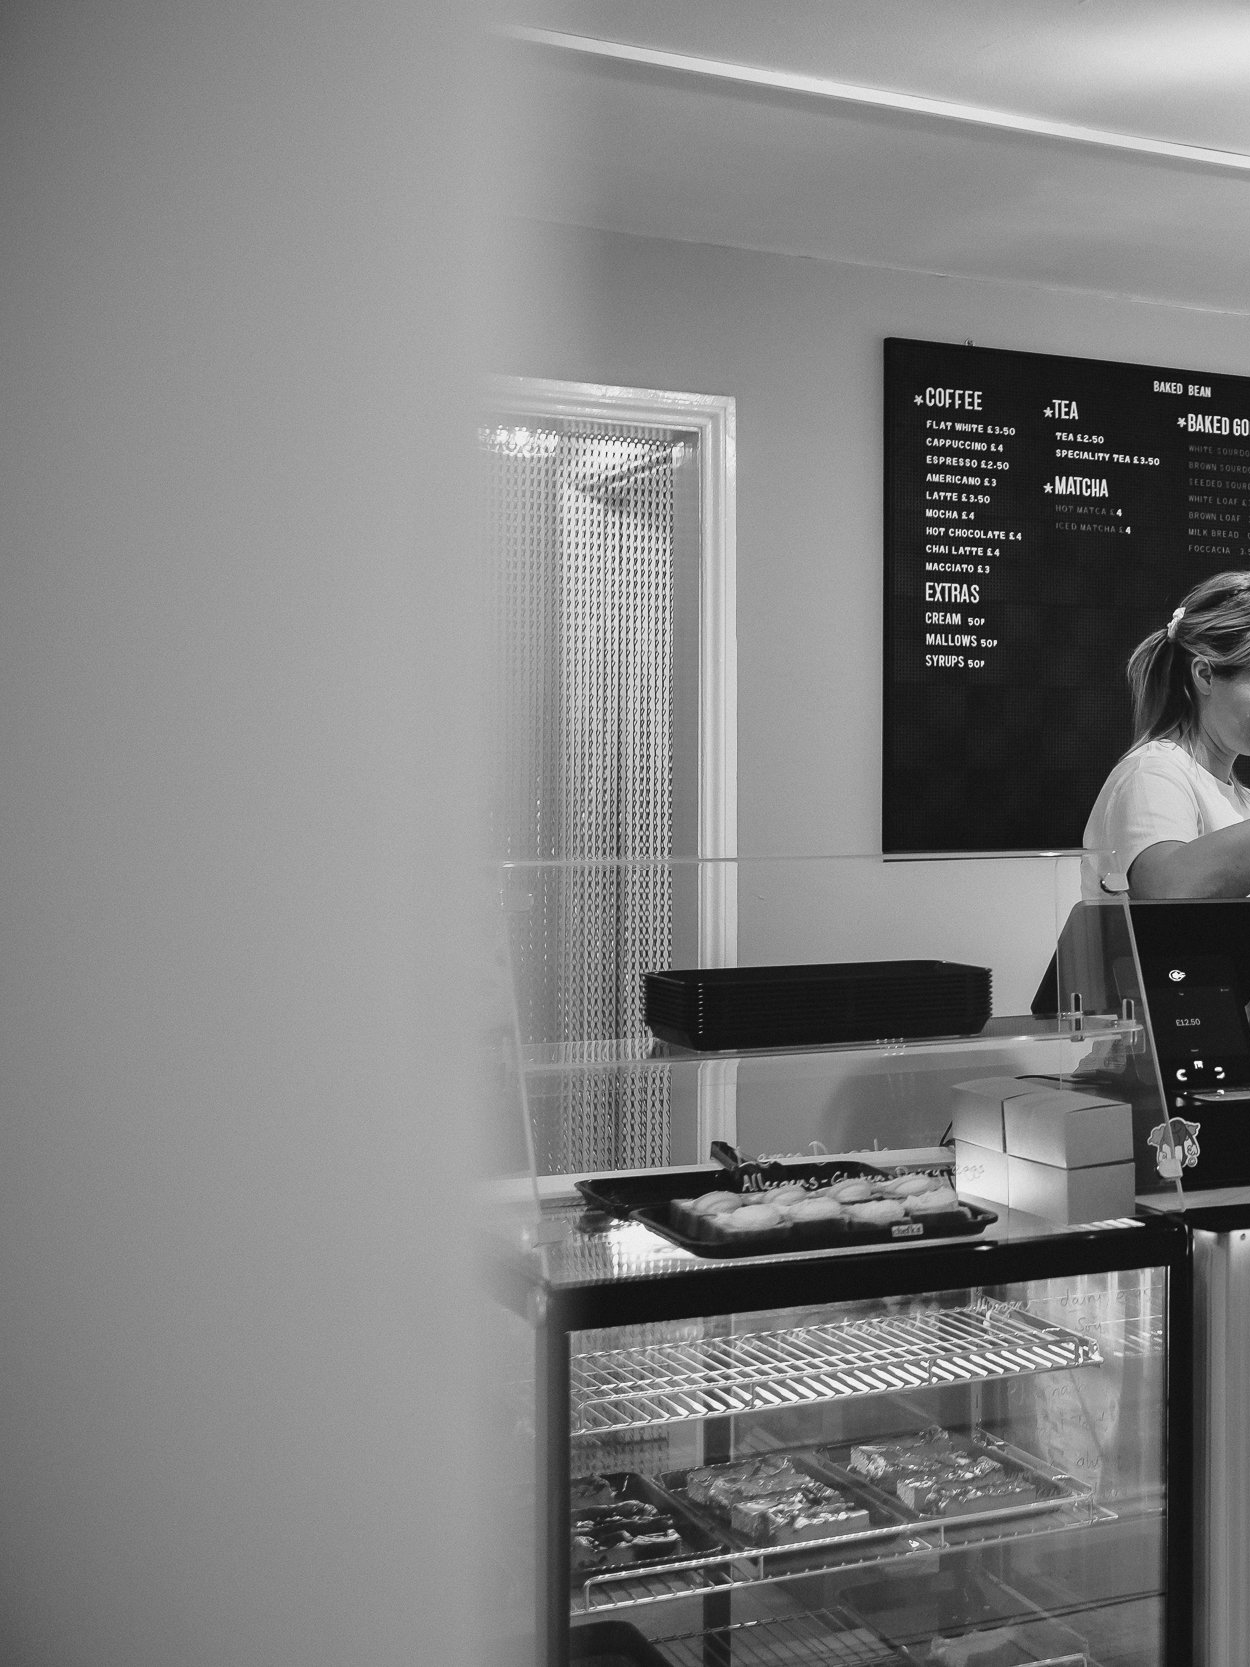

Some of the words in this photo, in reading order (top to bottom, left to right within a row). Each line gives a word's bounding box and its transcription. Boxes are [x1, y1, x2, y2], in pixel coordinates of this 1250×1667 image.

[1154, 381, 1183, 394] BAKED
[1188, 385, 1211, 397] BEAN
[926, 387, 982, 410] COFFEE
[1052, 400, 1078, 420] TEA
[927, 420, 952, 430] FLAT
[955, 423, 983, 433] WHITE
[987, 426, 1015, 435] £3.50
[1188, 414, 1229, 435] BAKED
[1056, 432, 1074, 441] TEA
[1077, 434, 1104, 443] £2.50
[926, 438, 987, 451] CAPPUCCINO
[991, 443, 1003, 452] £4
[927, 455, 977, 468] ESPRESSO
[981, 460, 1009, 470] £2.50
[1056, 449, 1110, 461] SPECIALITY
[1113, 454, 1130, 463] TEA
[1133, 456, 1160, 465] £3.50
[926, 473, 980, 485] AMERICANO
[984, 478, 996, 486] £3
[1055, 476, 1108, 497] MATCHA
[926, 491, 958, 501] LATTE
[962, 494, 990, 503] £3.50
[926, 509, 958, 519] MOCHA
[962, 511, 974, 520] £4
[926, 527, 945, 536] HOT
[949, 528, 1005, 539] CHOCOLATE
[1009, 532, 1022, 540] £4
[926, 545, 948, 553] CHAI
[952, 546, 983, 555] LATTE
[987, 548, 1000, 556] £4
[926, 562, 974, 573] MACCIATO
[977, 565, 990, 573] £3
[926, 582, 979, 603] EXTRAS
[926, 612, 961, 625] CREAM
[926, 634, 977, 647] MALLOWS
[926, 655, 964, 667] SYRUPS
[1175, 1018, 1201, 1027] £12.50
